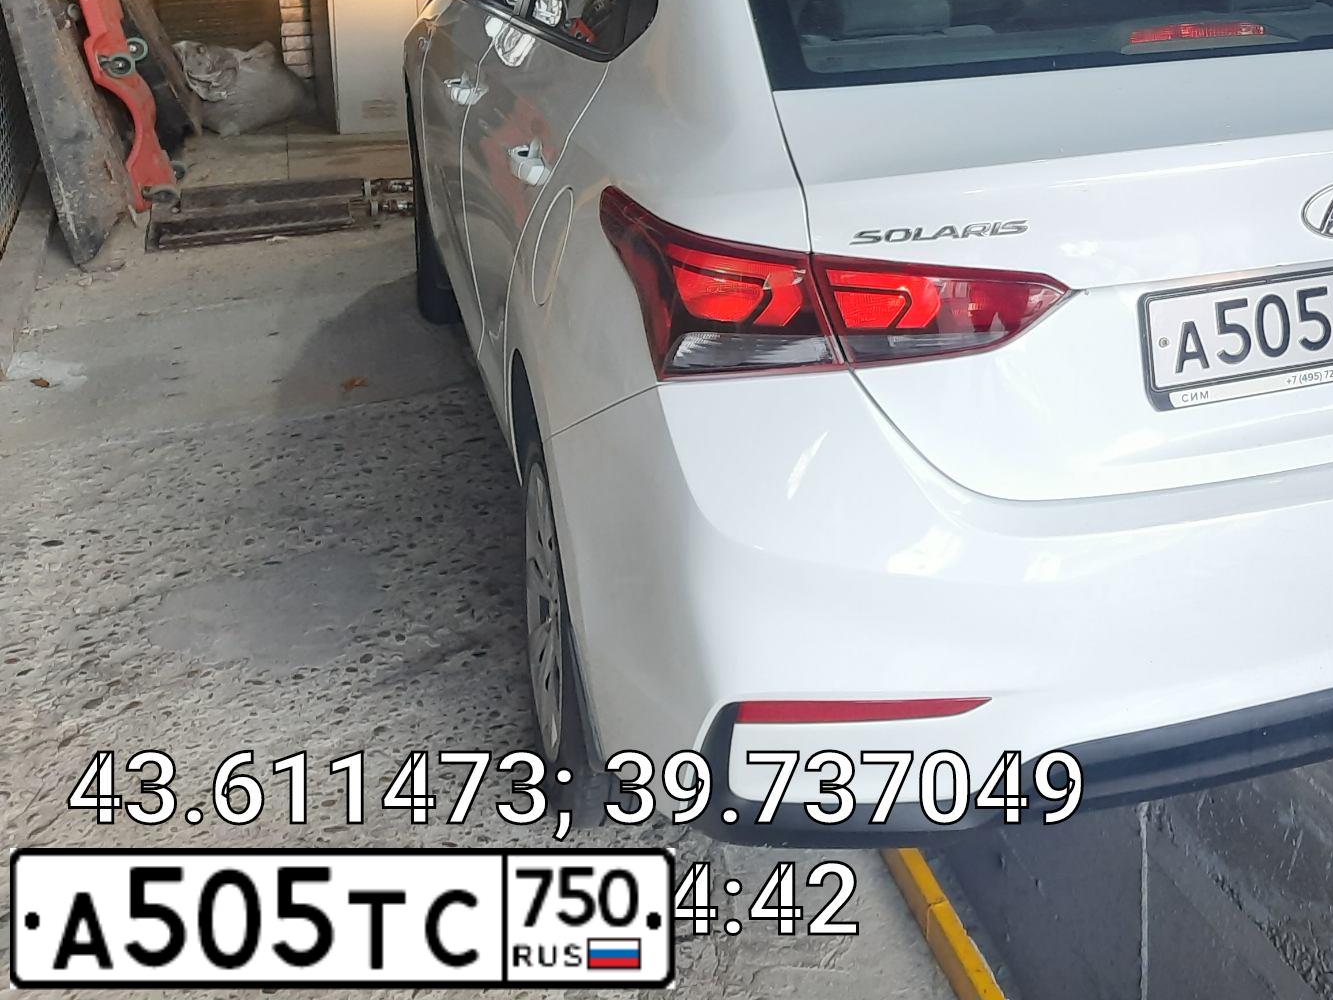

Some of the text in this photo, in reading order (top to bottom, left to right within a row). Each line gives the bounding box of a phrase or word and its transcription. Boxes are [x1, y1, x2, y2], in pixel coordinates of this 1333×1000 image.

[849, 219, 1028, 246] SOLARIS
[1286, 376, 1297, 385] +7
[1299, 371, 1323, 383] (495)
[1181, 391, 1210, 403] СИМ
